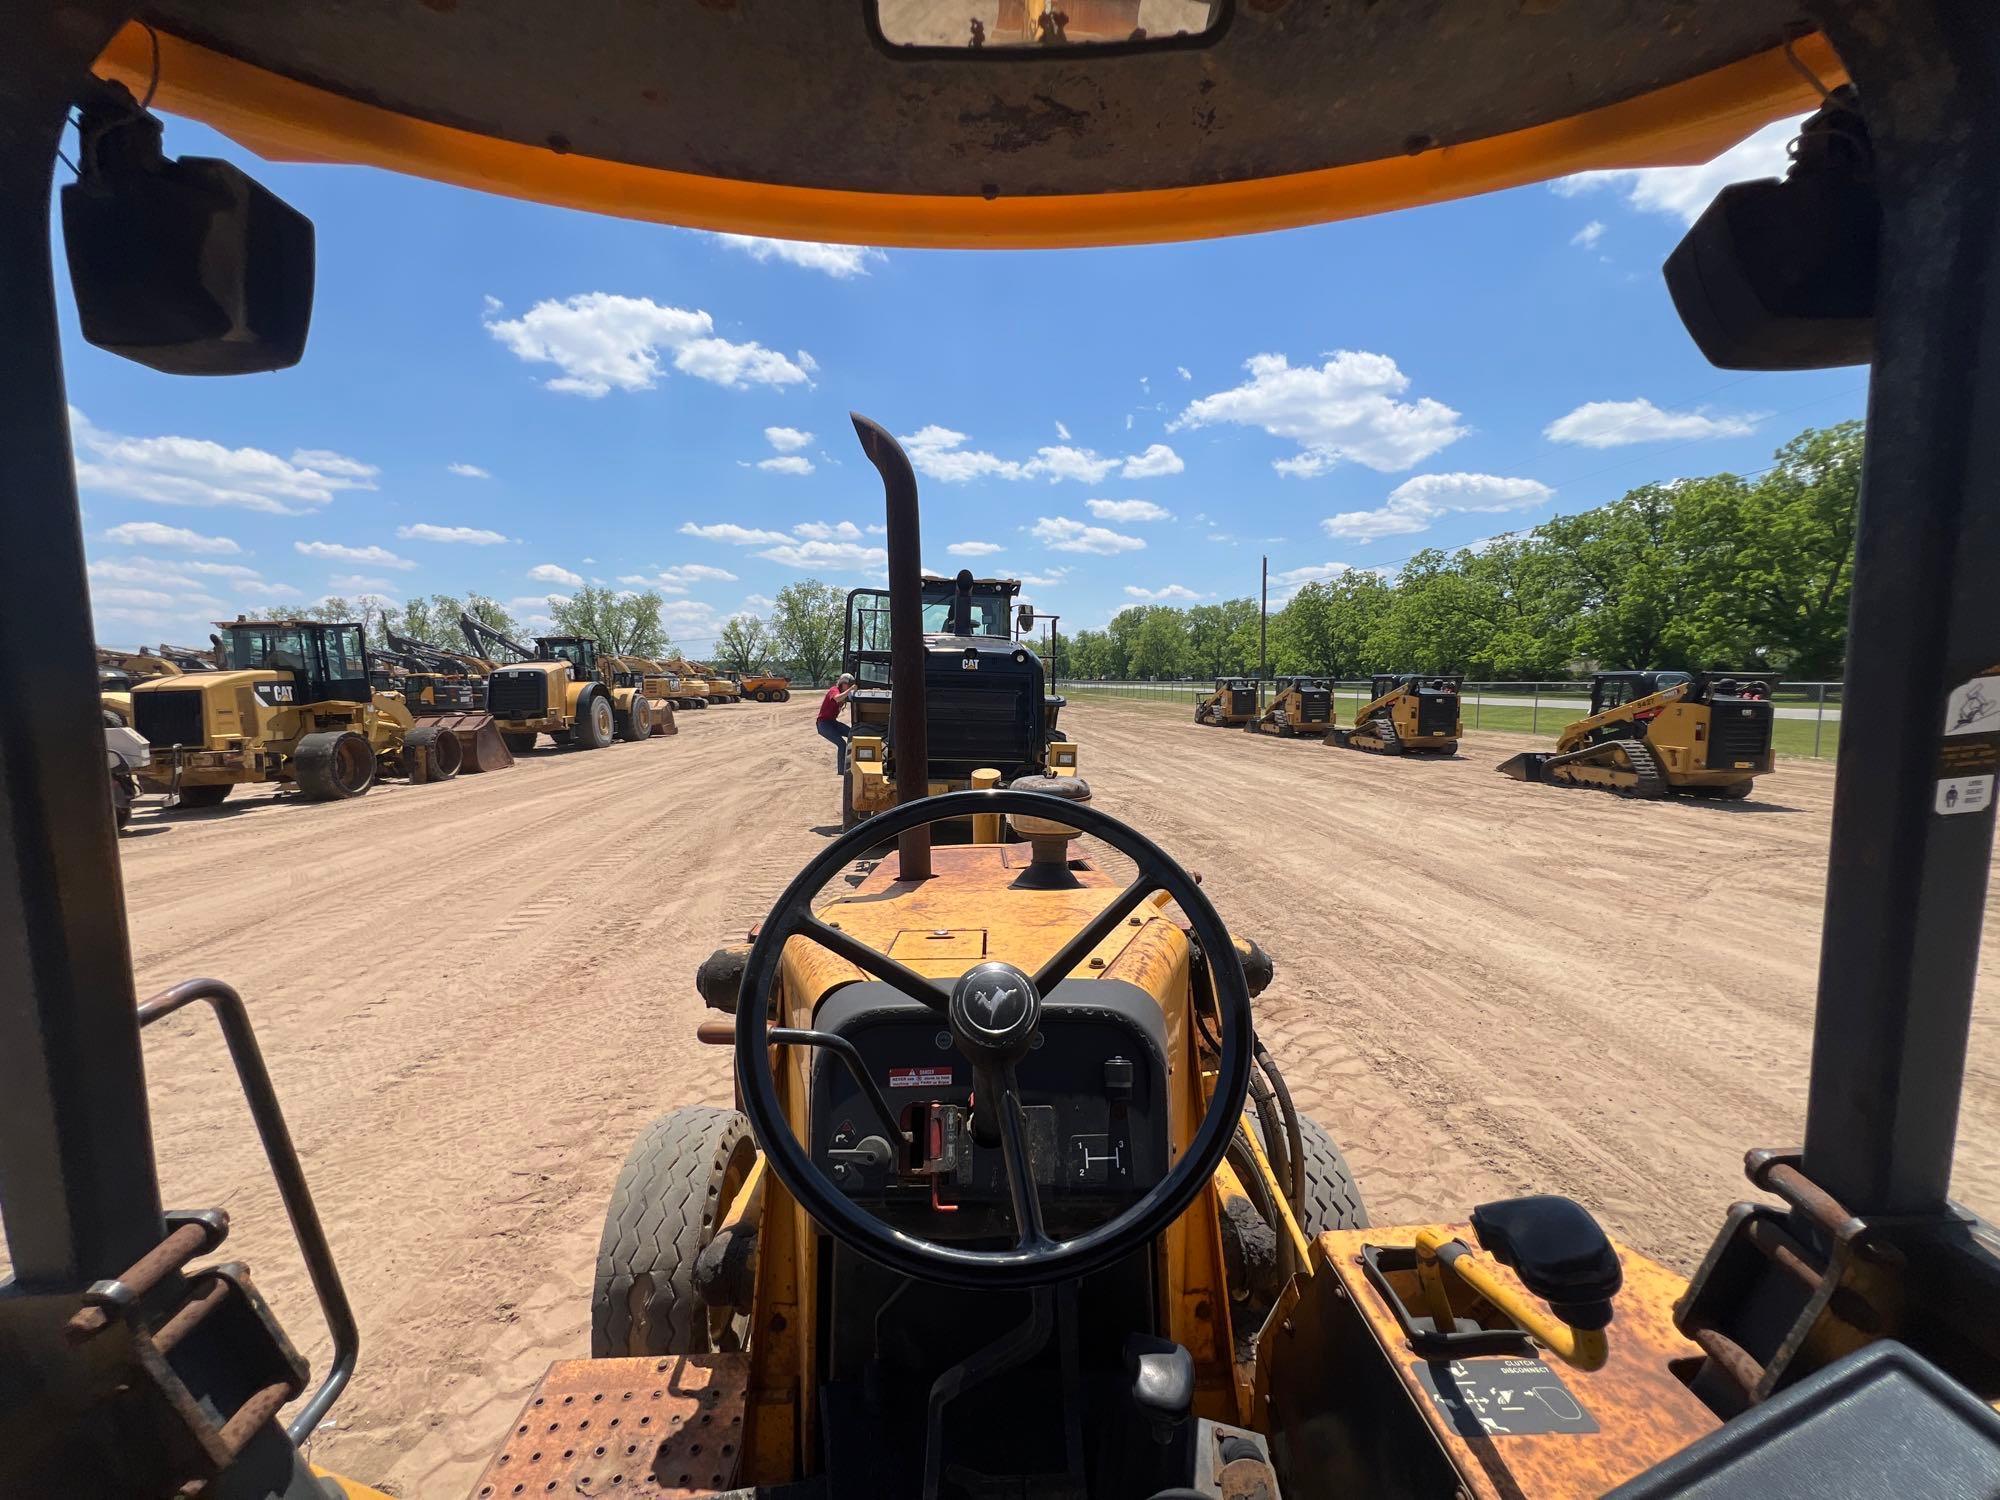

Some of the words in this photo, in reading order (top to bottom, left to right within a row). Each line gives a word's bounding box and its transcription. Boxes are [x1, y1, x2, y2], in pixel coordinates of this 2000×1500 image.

[962, 659, 980, 670] CAT
[273, 685, 293, 702] CAT
[1077, 1141, 1082, 1149] 1
[1118, 1140, 1124, 1148] 3
[1079, 1169, 1085, 1177] 2
[1120, 1167, 1126, 1175] 4
[1500, 1366, 1550, 1374] DISCONNECT
